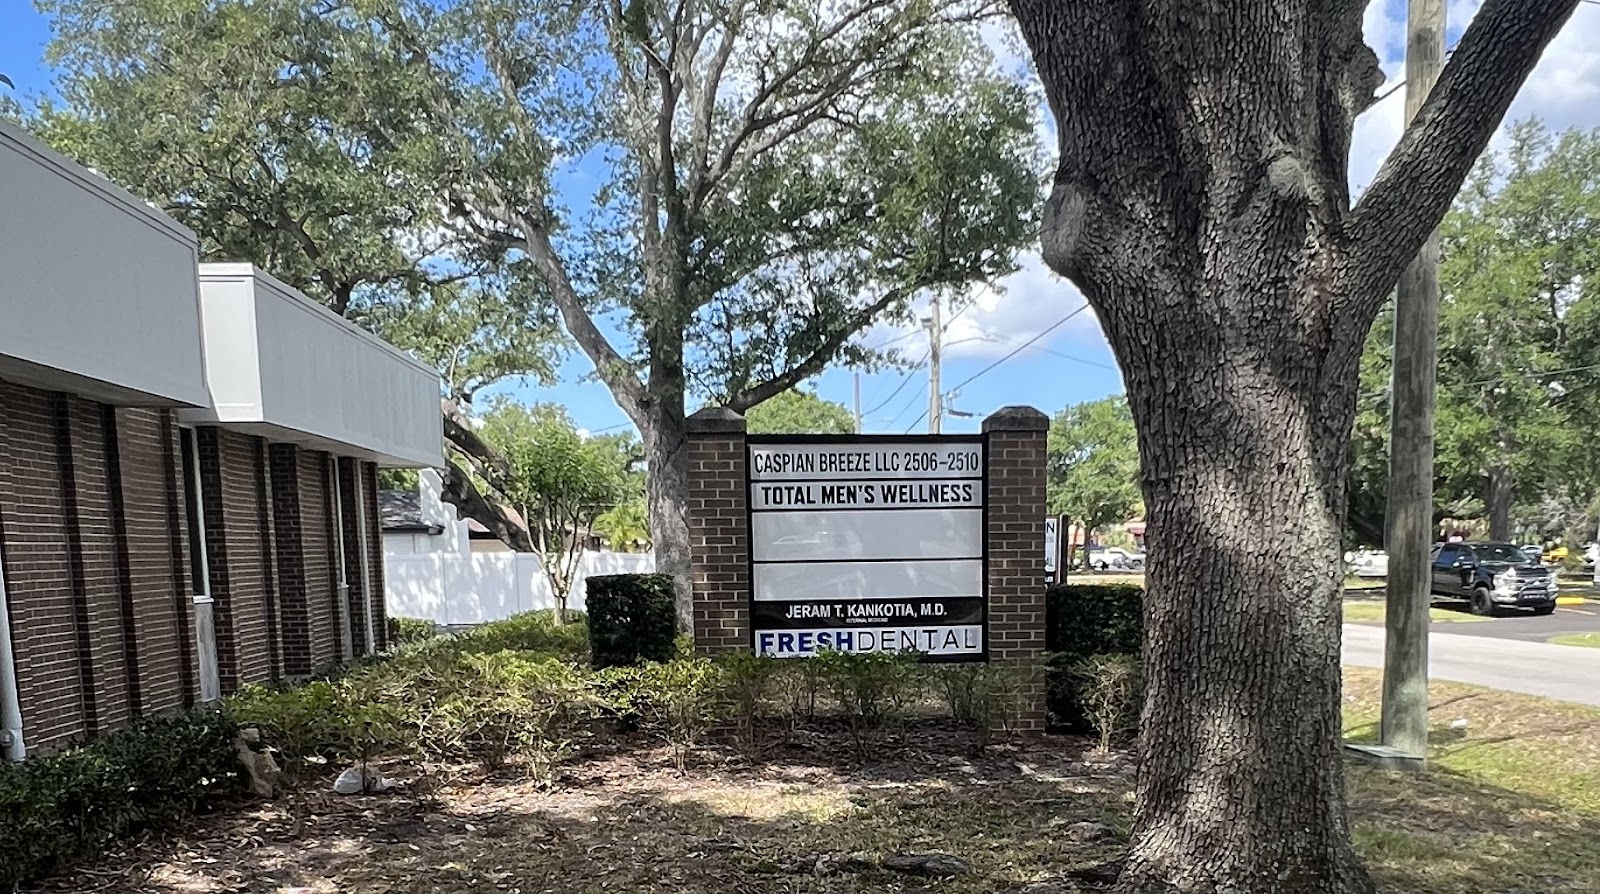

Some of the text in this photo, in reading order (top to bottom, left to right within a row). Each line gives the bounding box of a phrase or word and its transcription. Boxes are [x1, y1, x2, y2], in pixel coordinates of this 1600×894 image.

[754, 452, 979, 473] CASPIAN BREEZE LLC 2506-2510
[761, 484, 973, 505] TOTAL MEN'S WELLNESS
[785, 603, 948, 619] JERAM T. KANKOTIA, M.D.
